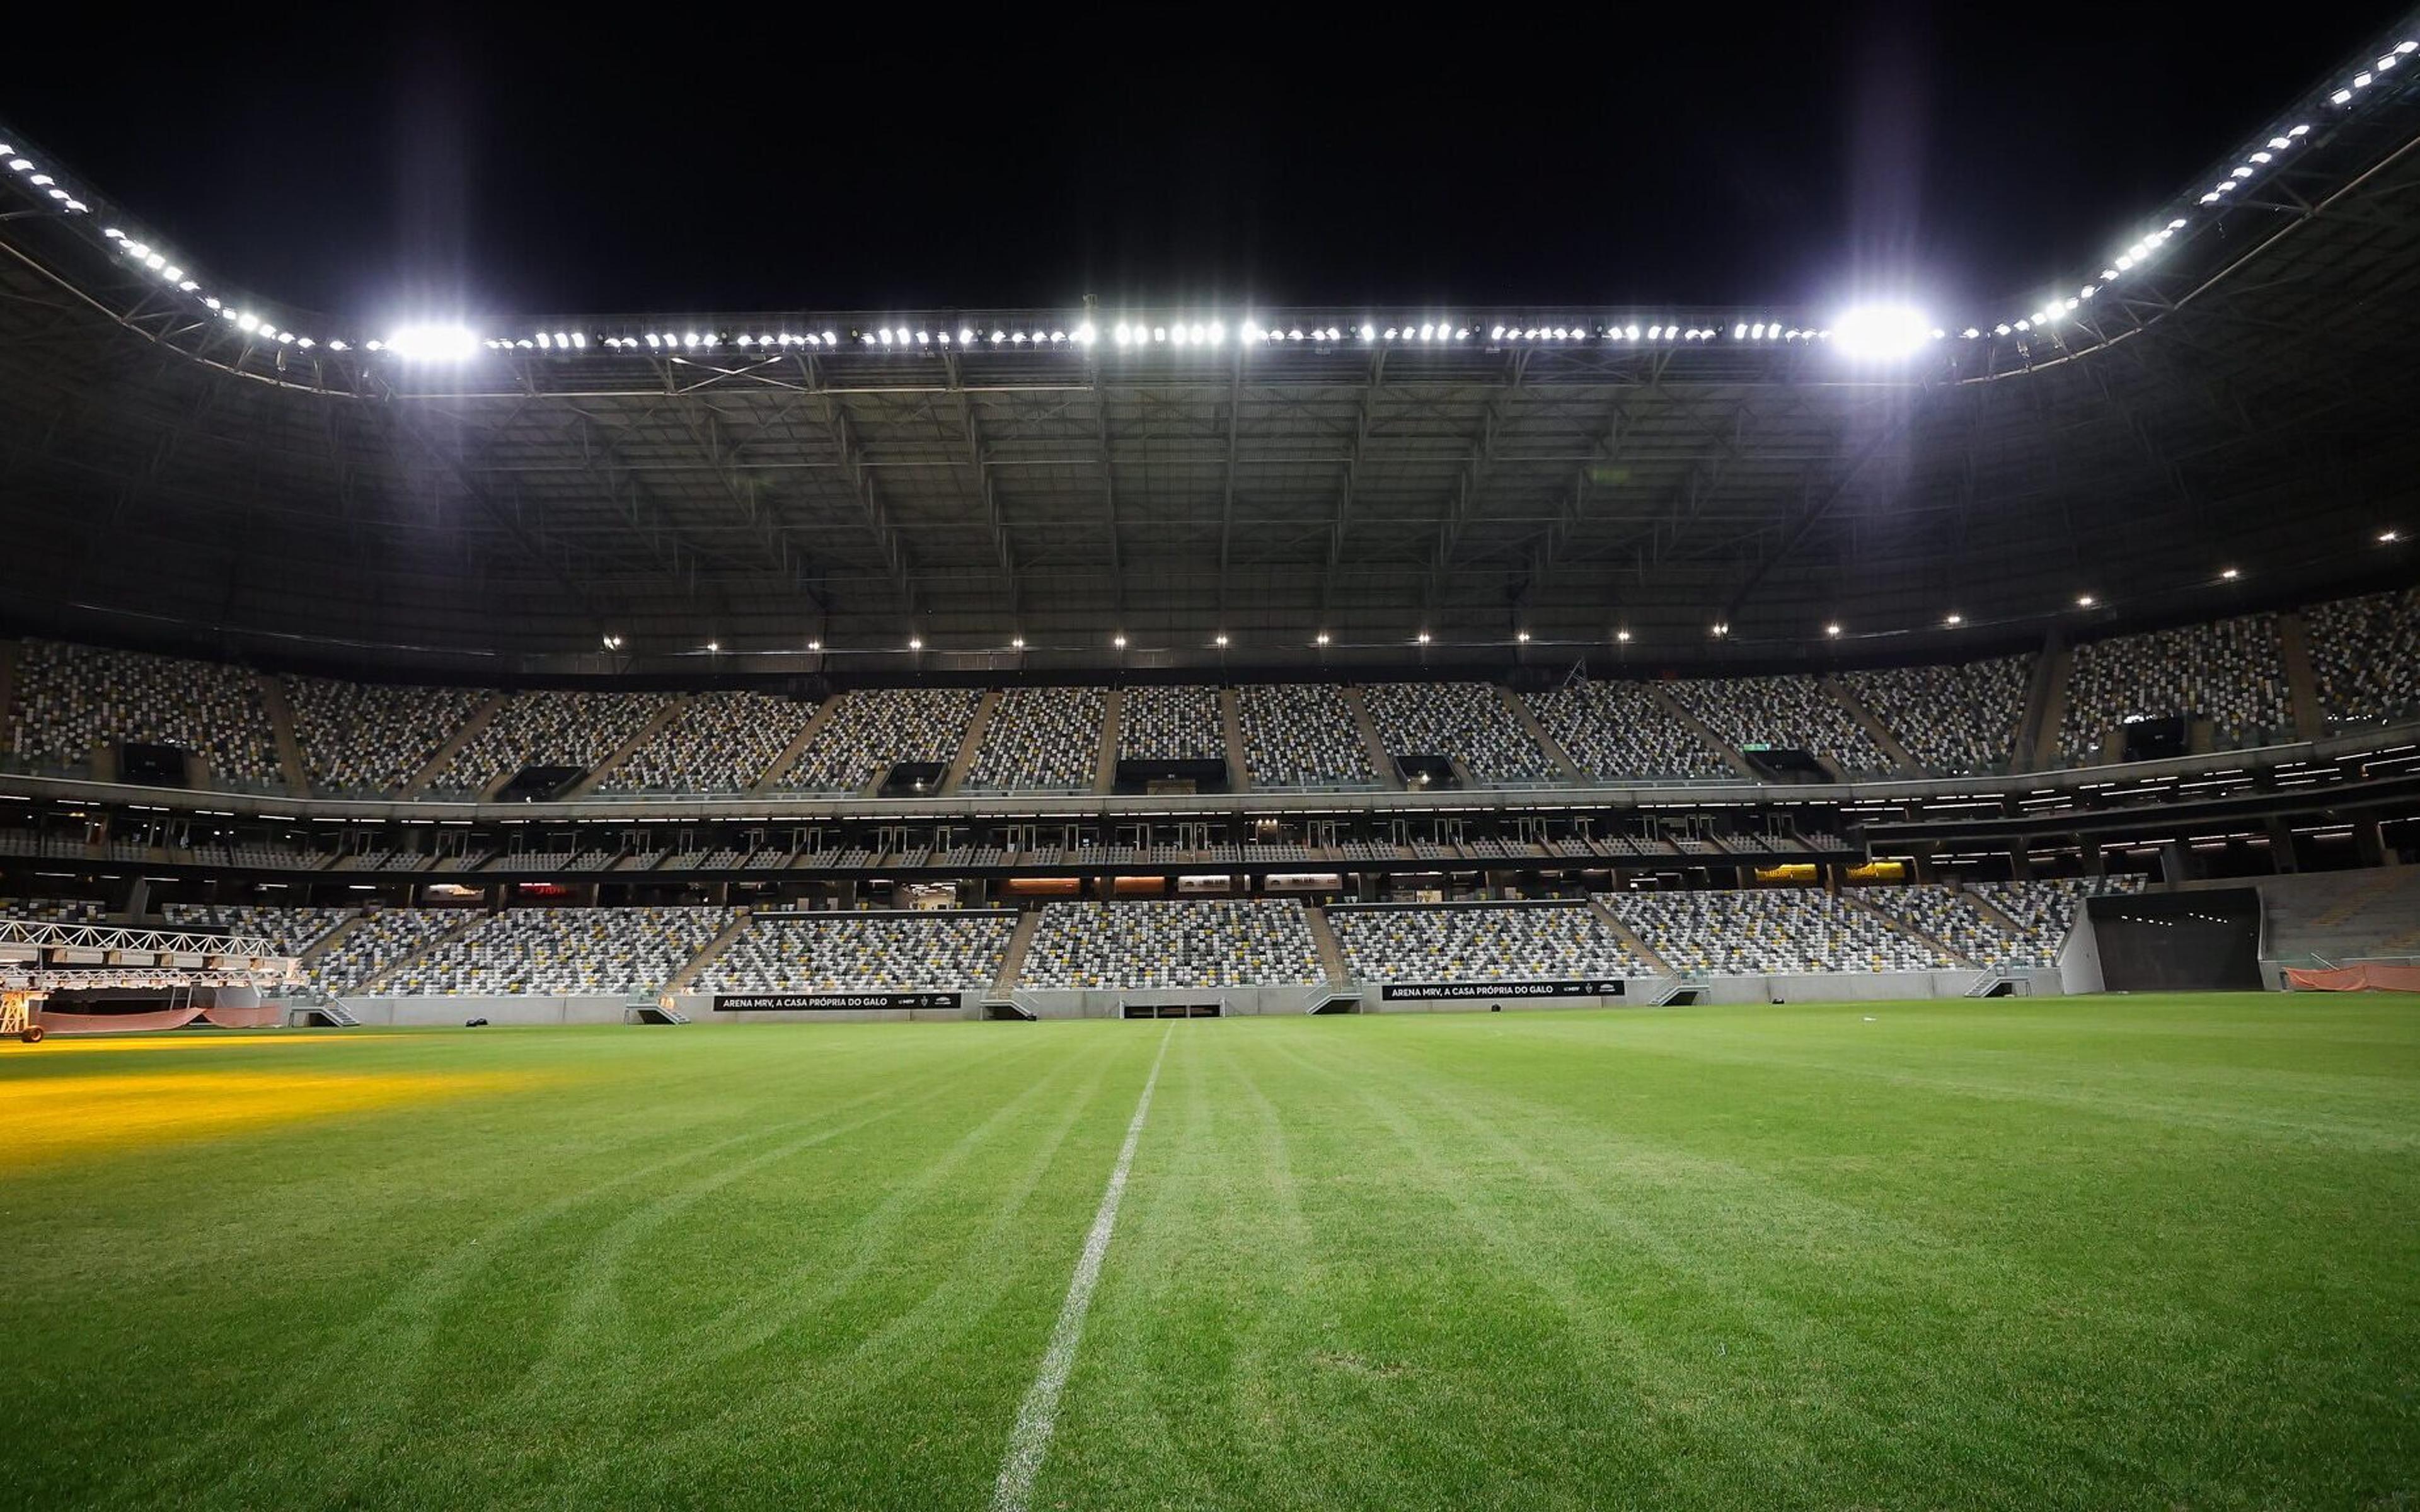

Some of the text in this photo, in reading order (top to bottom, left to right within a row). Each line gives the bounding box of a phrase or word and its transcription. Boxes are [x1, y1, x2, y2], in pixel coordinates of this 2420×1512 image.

[1392, 988, 1421, 997] ARENA
[1422, 988, 1443, 997] MRV,
[1451, 987, 1475, 995] CASA
[1477, 985, 1514, 995] PRÓPRIA
[1514, 986, 1528, 994] DO
[1529, 985, 1554, 994] GALO
[723, 999, 752, 1007] ARENA
[754, 999, 774, 1009] MRV,
[784, 999, 807, 1007] CASA
[809, 997, 846, 1007] PRÓPRIA
[848, 998, 861, 1006] DO
[863, 997, 888, 1006] GALO
